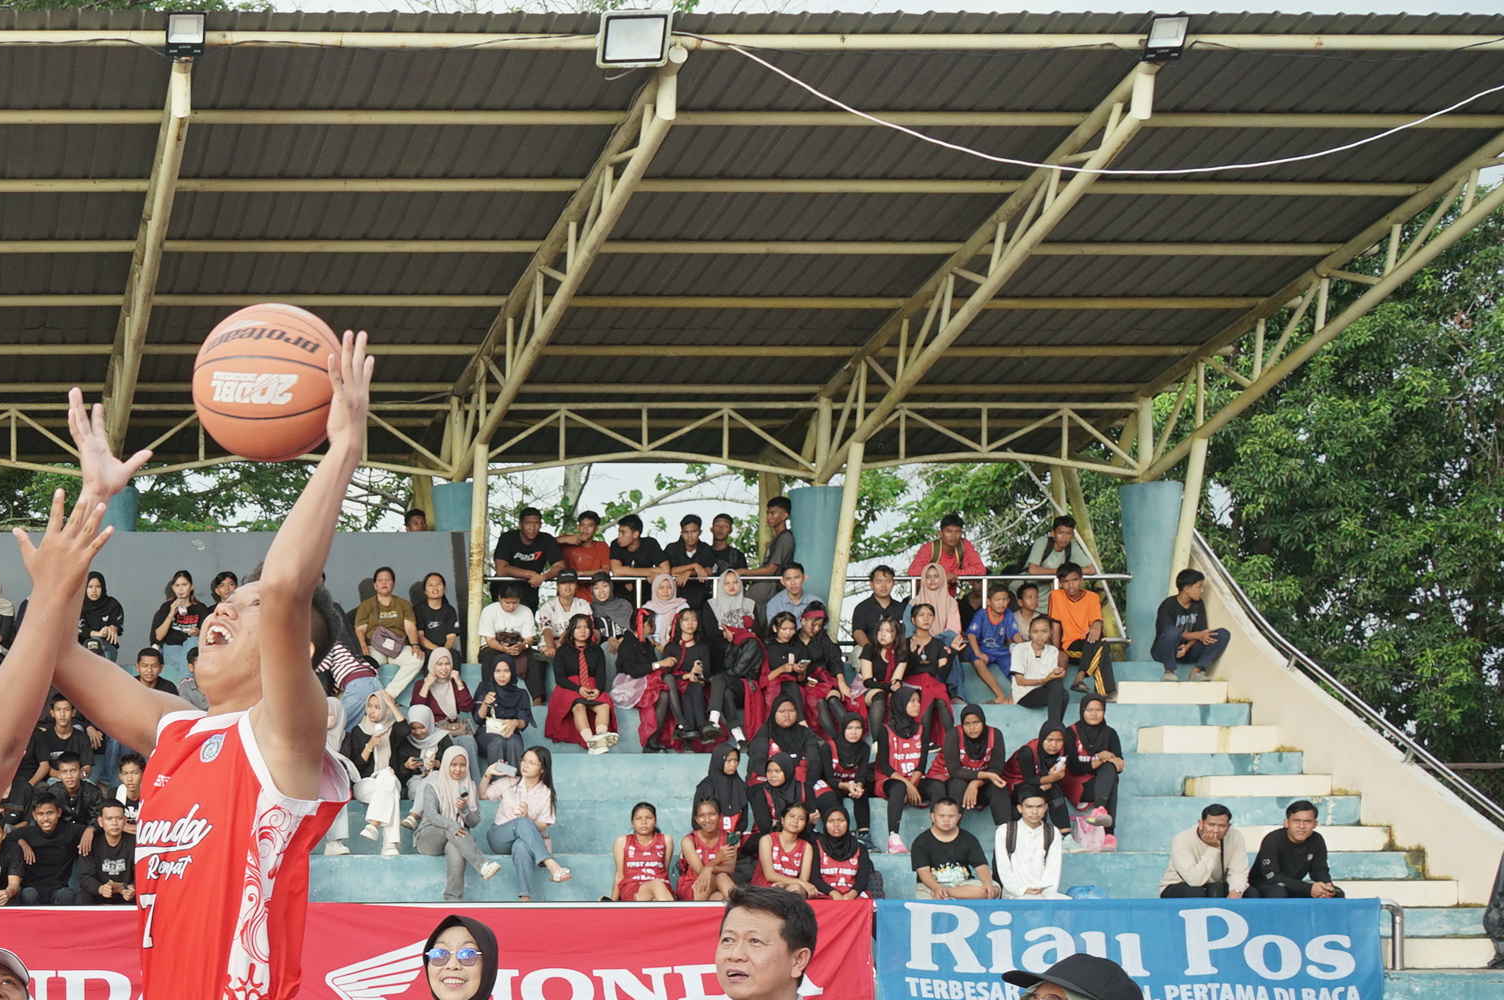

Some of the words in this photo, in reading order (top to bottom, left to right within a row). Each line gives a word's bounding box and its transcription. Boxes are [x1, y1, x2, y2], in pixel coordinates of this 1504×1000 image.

[139, 894, 157, 949] 7
[904, 902, 1151, 977] Riau
[1179, 907, 1356, 980] Pos
